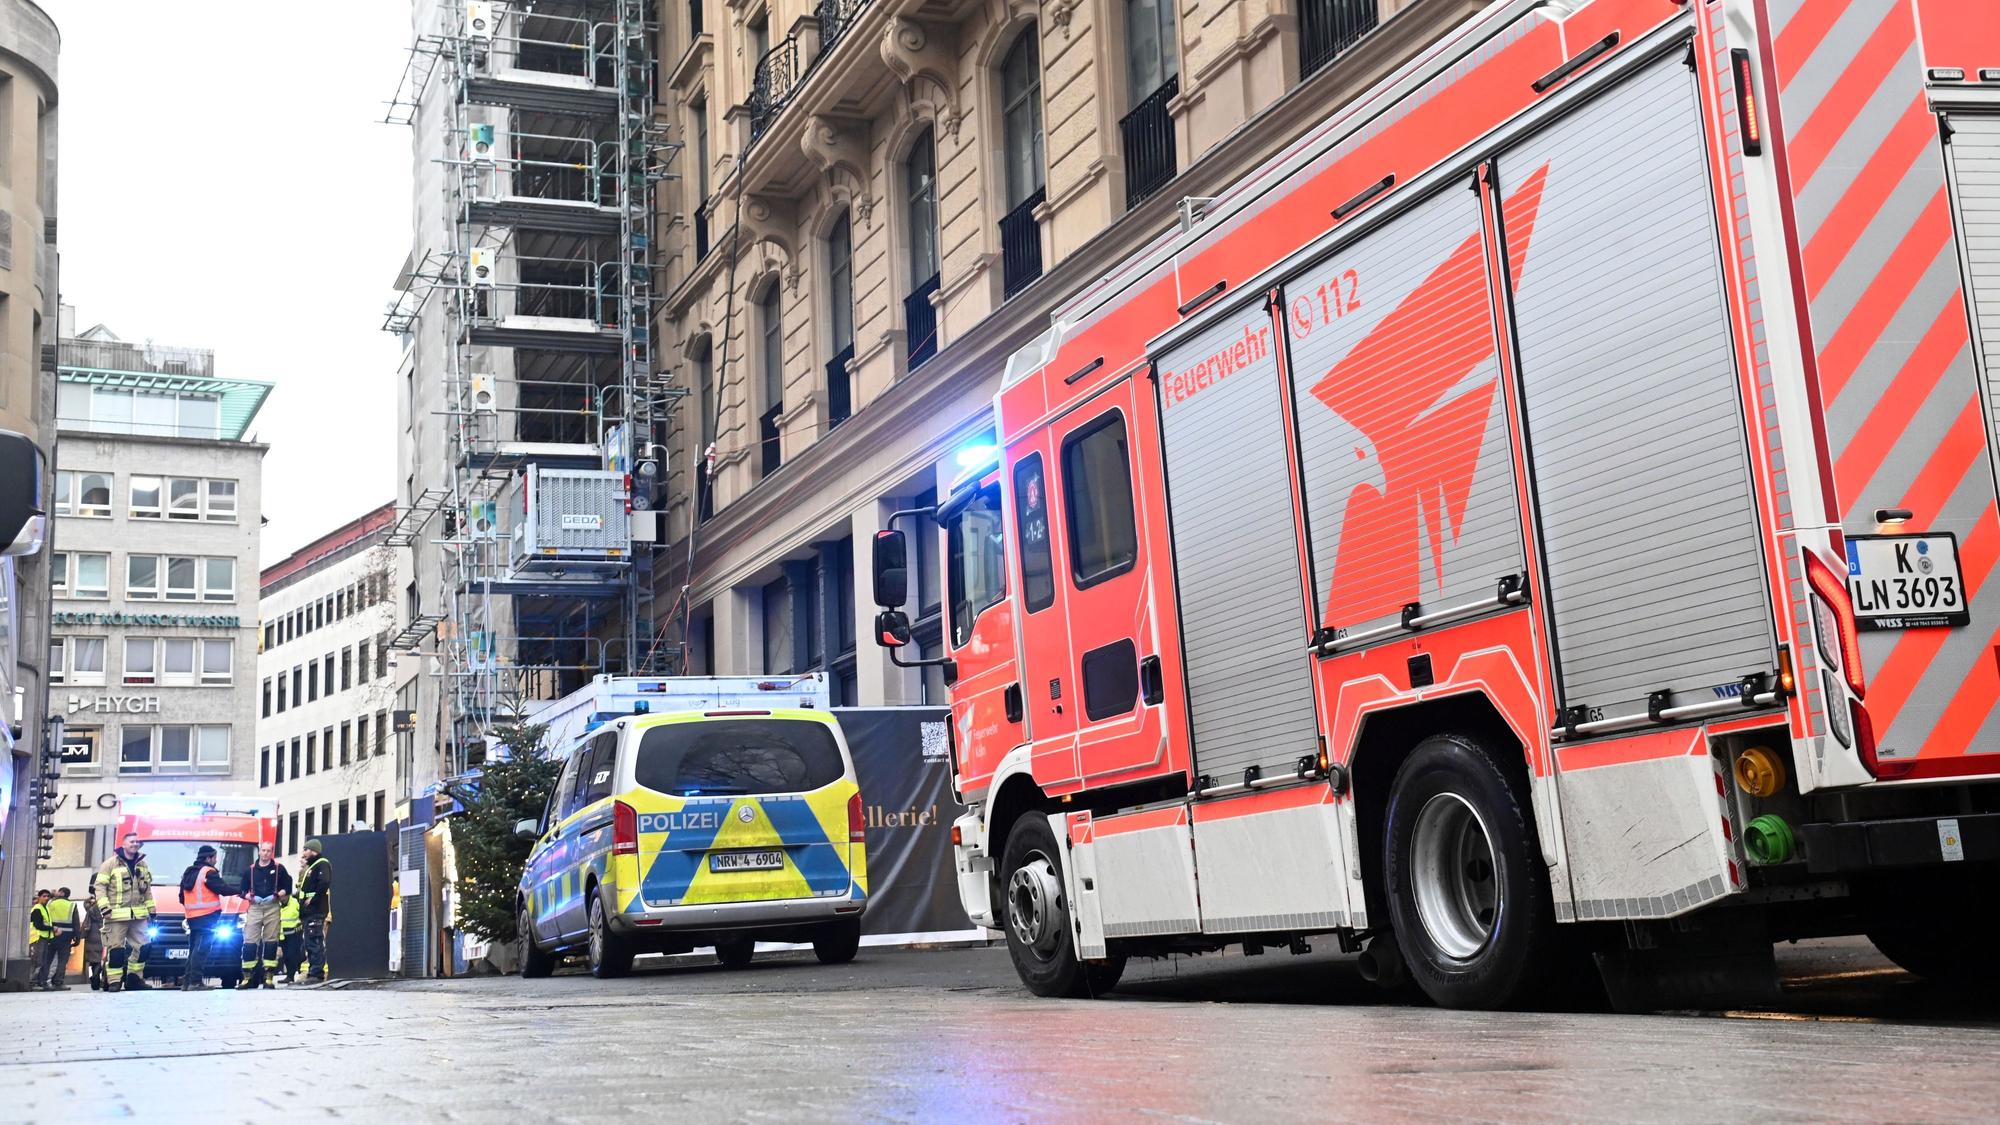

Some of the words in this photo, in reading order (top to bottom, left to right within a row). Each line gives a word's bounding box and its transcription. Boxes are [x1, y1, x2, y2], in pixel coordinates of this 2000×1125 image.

[1317, 268, 1361, 325] 112
[1162, 324, 1270, 410] Feuerwehr
[563, 516, 599, 524] GEDA
[1849, 562, 1857, 571] D
[1895, 543, 1913, 573] K
[1855, 579, 1890, 611] LN
[1893, 577, 1956, 609] 3693
[54, 612, 96, 626] ECHT
[101, 610, 179, 627] KÖLNISCH
[185, 614, 241, 628] WASSER
[1874, 618, 1903, 628] WISS
[1338, 628, 1348, 639] G3
[95, 696, 160, 714] HYGH
[1590, 707, 1604, 722] G5
[640, 812, 719, 832] POLIZEI
[864, 804, 937, 829] llerie!
[151, 828, 244, 838] Rettungsdienst
[716, 854, 738, 867] NRW
[743, 852, 782, 867] 4-6904
